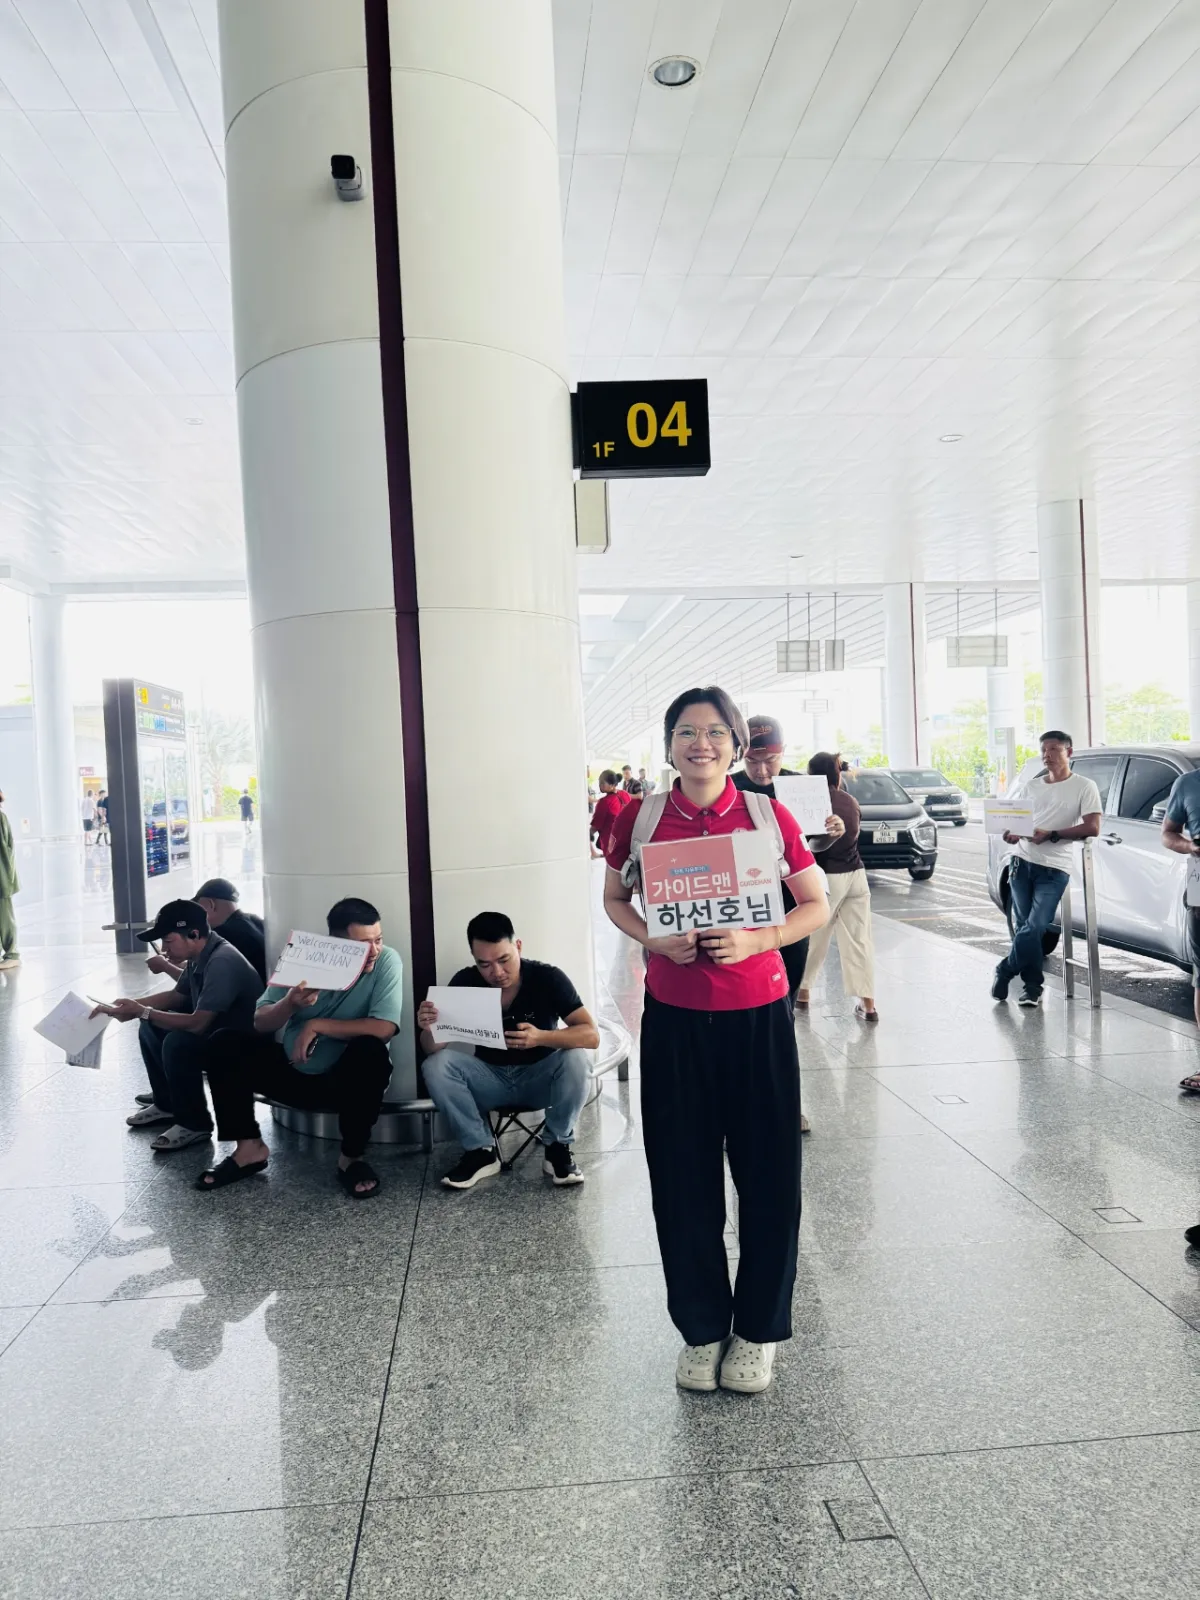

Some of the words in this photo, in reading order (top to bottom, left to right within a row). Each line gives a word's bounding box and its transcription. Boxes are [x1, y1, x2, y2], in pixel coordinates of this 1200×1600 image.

[592, 441, 615, 458] 1F
[626, 401, 692, 448] 04
[652, 871, 733, 901] 가이드맨
[739, 878, 772, 887] GUIDEMAN
[657, 893, 772, 931] 하선호님
[306, 950, 328, 964] WON
[329, 953, 352, 968] HAN
